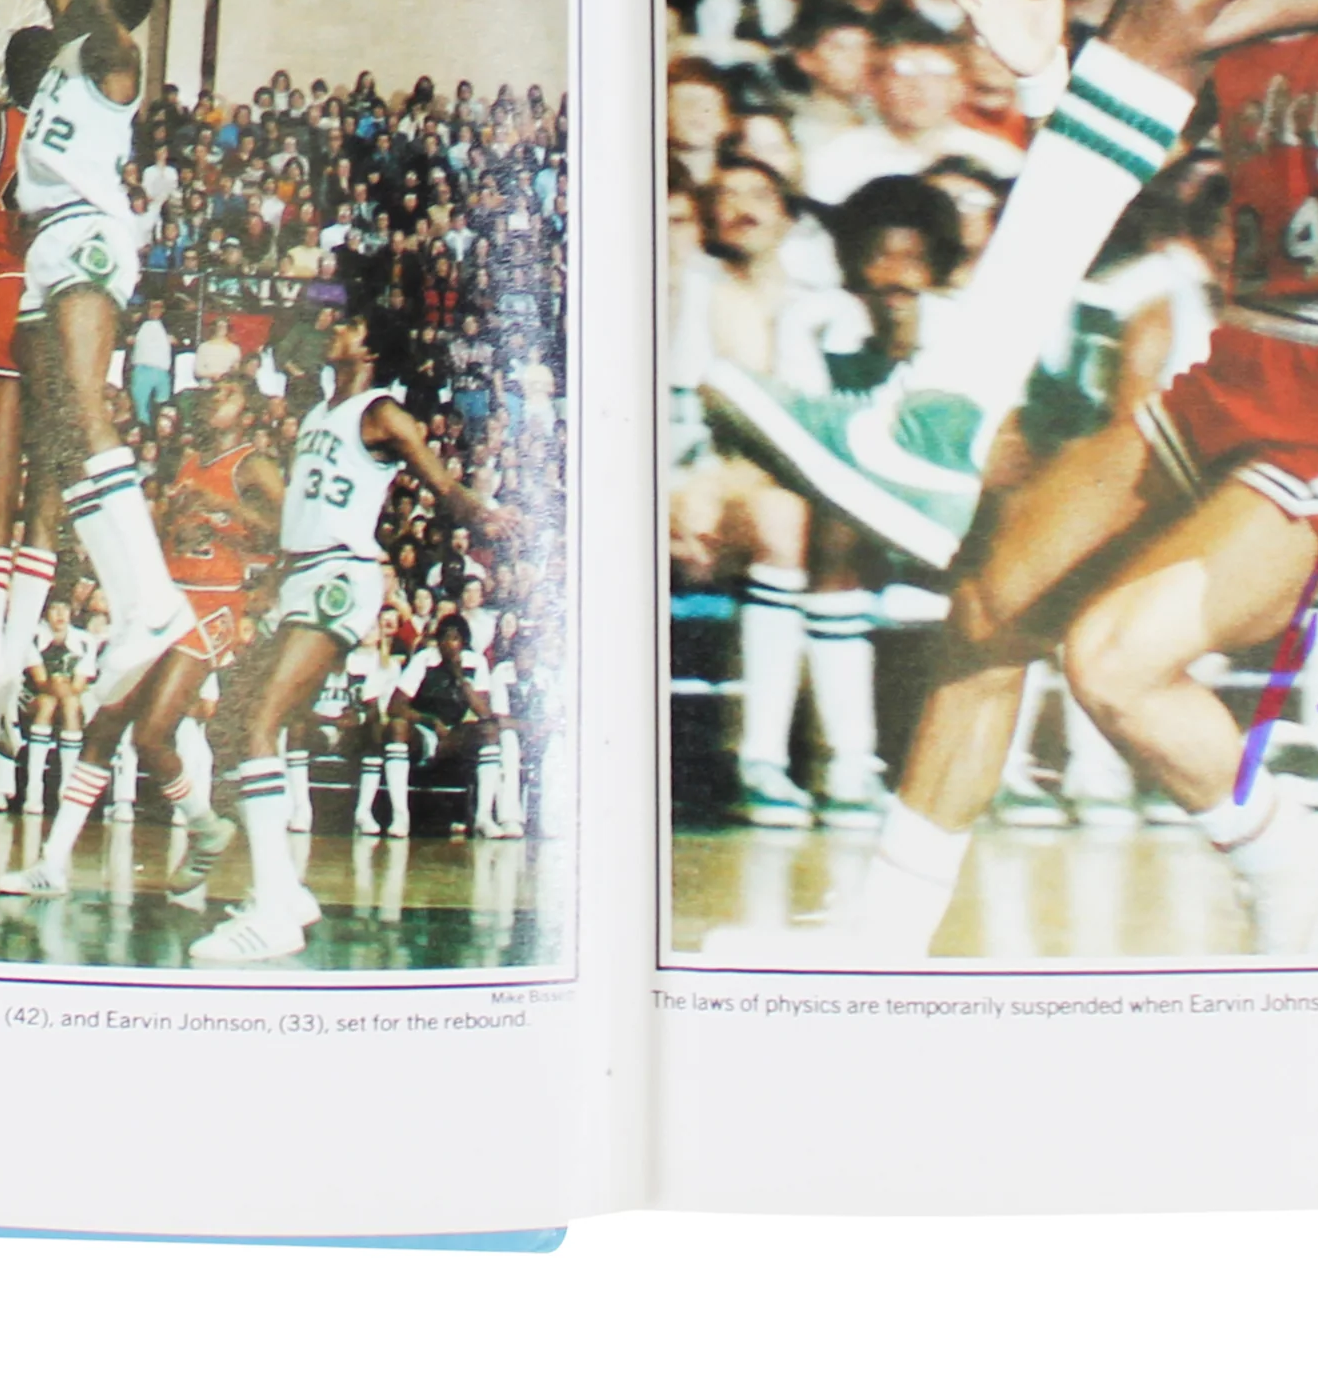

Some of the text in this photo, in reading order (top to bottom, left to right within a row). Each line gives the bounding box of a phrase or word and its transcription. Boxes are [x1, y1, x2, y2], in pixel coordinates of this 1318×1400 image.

[304, 468, 356, 509] 33
[649, 990, 687, 1010] The
[691, 992, 735, 1013] laws
[739, 993, 760, 1013] of
[765, 995, 842, 1018] physics
[846, 999, 880, 1015] are
[884, 997, 1006, 1019] temporarily
[1010, 997, 1124, 1018] suspended
[1128, 996, 1184, 1014] when
[1189, 993, 1255, 1015] Earvin
[4, 1006, 54, 1029] (42),
[60, 1011, 100, 1029] and
[105, 1010, 172, 1030] Earvin
[177, 1013, 273, 1034] Johnson,
[278, 1013, 330, 1036] (33),
[335, 1016, 367, 1033] set
[371, 1013, 402, 1032] for
[406, 1013, 439, 1032] the
[443, 1010, 530, 1031] rebound.
